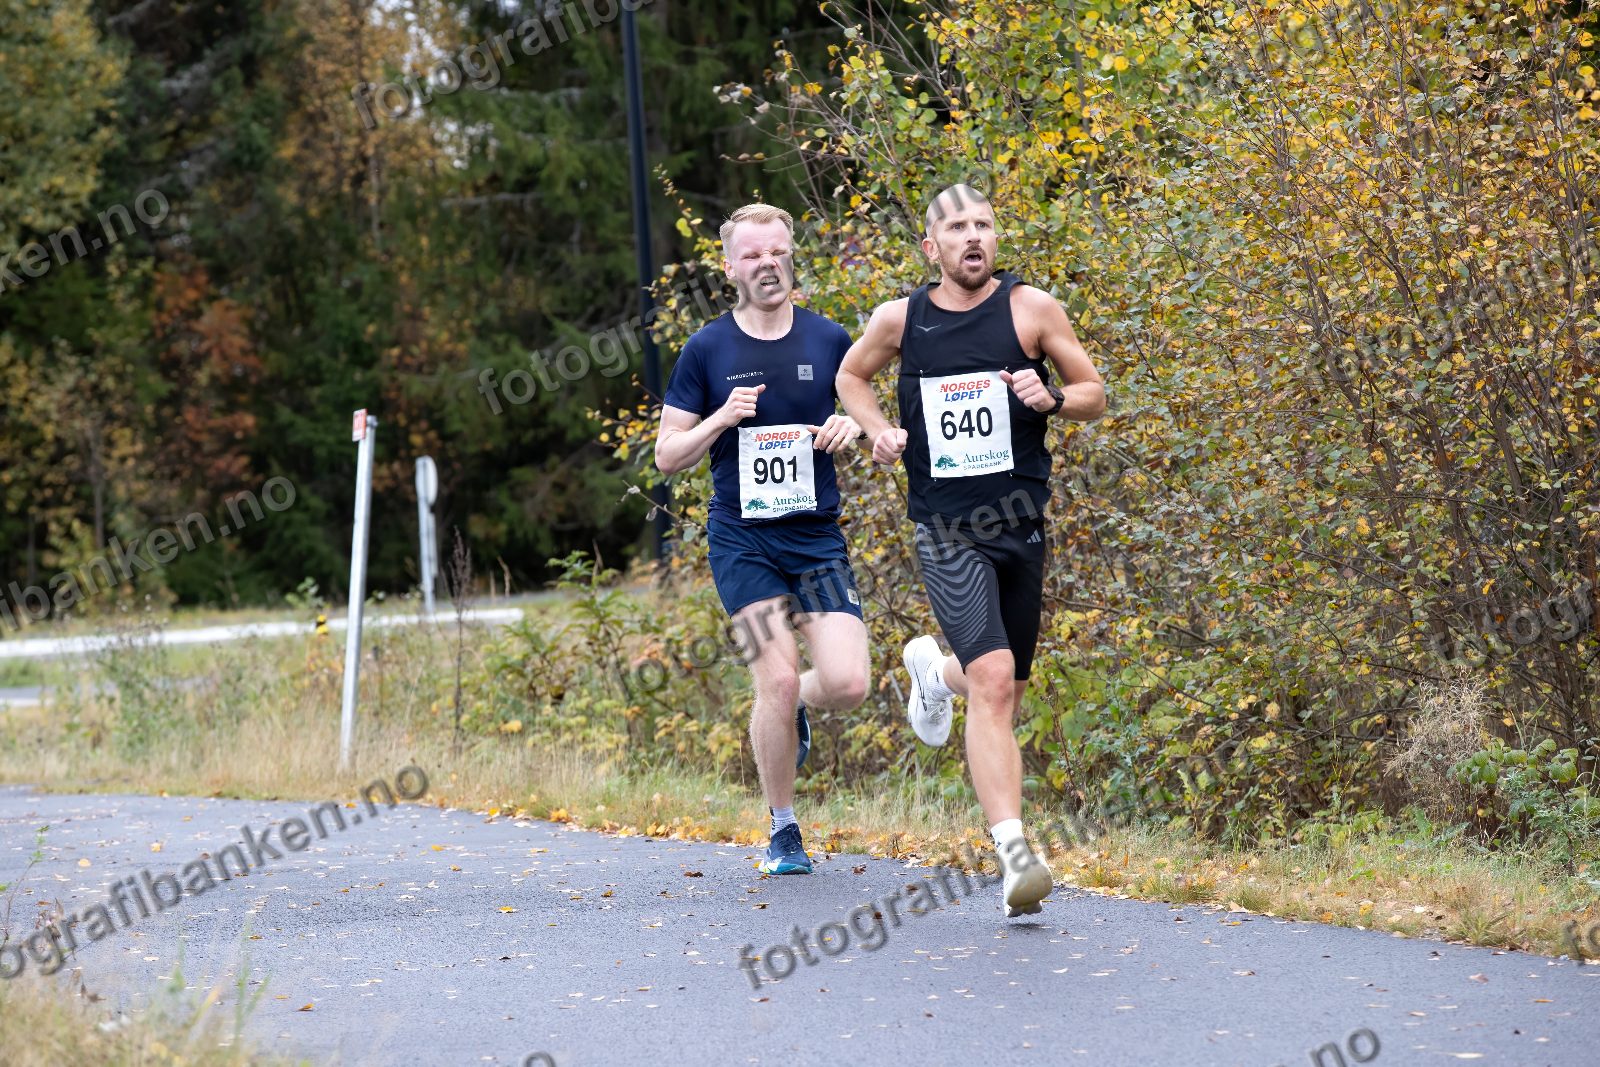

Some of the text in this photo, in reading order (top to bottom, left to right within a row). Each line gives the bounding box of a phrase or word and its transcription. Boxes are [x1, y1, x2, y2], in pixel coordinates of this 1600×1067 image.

[940, 379, 991, 393] NORGES
[944, 389, 984, 403] LØPET
[940, 406, 993, 441] 640
[754, 430, 801, 442] NORGES
[758, 439, 795, 451] LØPET
[962, 449, 1010, 464] Aurskog
[753, 455, 798, 485] 901
[772, 494, 816, 506] Aurskog
